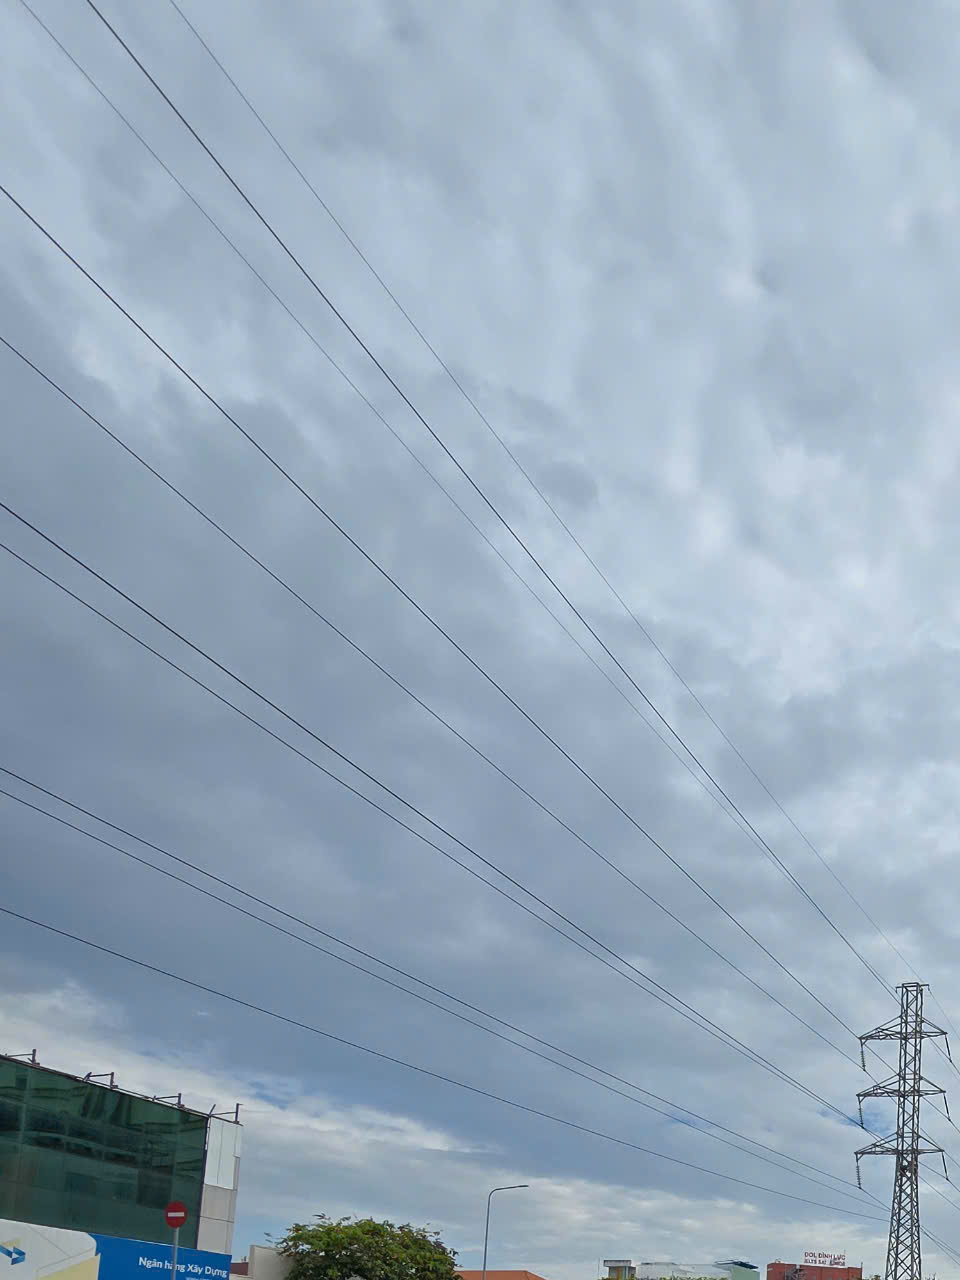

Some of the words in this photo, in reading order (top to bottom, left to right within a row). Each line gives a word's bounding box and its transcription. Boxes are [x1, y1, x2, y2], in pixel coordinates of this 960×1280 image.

[138, 1256, 162, 1269] Ngân
[187, 1263, 203, 1275] Xây
[204, 1265, 228, 1278] Dựng
